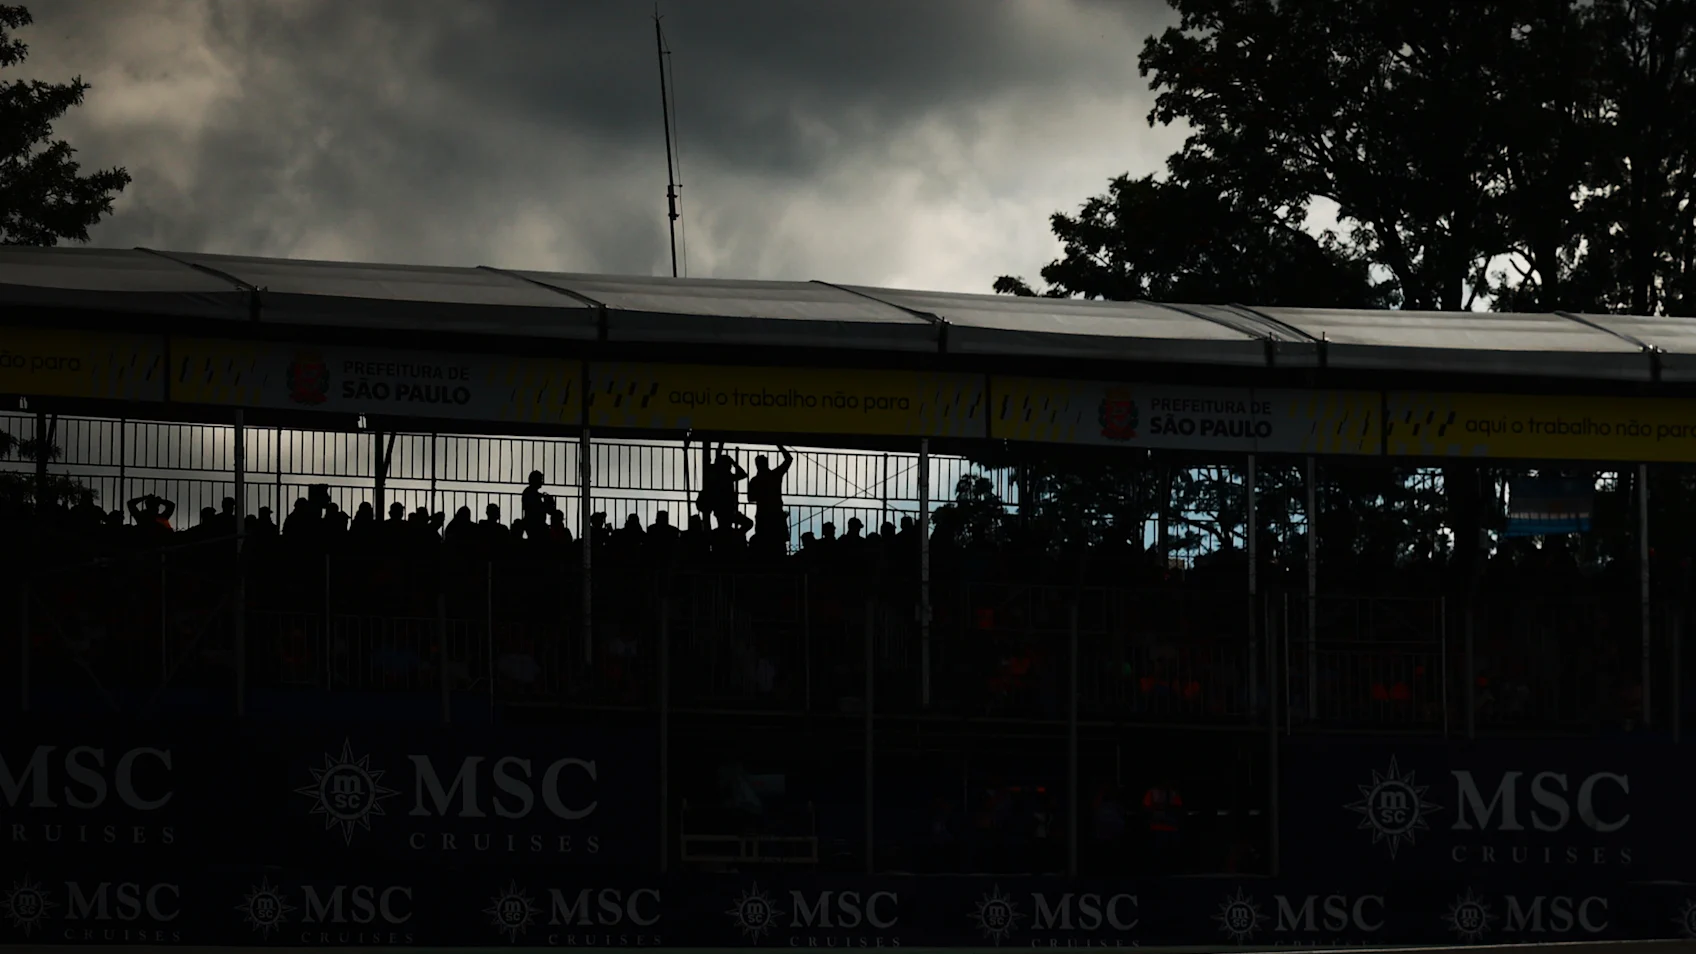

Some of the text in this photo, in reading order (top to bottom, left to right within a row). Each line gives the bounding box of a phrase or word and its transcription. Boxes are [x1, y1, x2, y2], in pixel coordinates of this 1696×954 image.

[0, 349, 81, 374] ão para
[343, 360, 470, 381] PREFEITURA DE
[342, 377, 471, 405] SÃO PAULO
[668, 387, 910, 414] aqui o trabalho não para
[1151, 398, 1272, 415] PREFEITURA DE
[1150, 413, 1273, 438] SÃO PAULO
[1465, 414, 1507, 437] aqui
[1511, 420, 1524, 434] o
[1528, 417, 1611, 436] trabalho
[1616, 419, 1652, 437] não
[0, 745, 174, 810] MSC
[407, 754, 598, 820] MSC
[1450, 770, 1631, 832] MSC
[11, 823, 175, 844] RUISES
[409, 832, 600, 854] CRUISES
[1451, 846, 1632, 864] CRUISES
[64, 881, 180, 921] MSC
[300, 885, 413, 924] MSC
[547, 888, 662, 926] MSC
[789, 890, 899, 928] MSC
[1030, 892, 1139, 930] MSC
[1273, 894, 1385, 931] MSC
[1503, 894, 1609, 932] MSC
[64, 928, 181, 942] CRUISES
[301, 931, 413, 944] CRUISES
[548, 933, 662, 946] CRUISES
[789, 936, 900, 947] CRUISES
